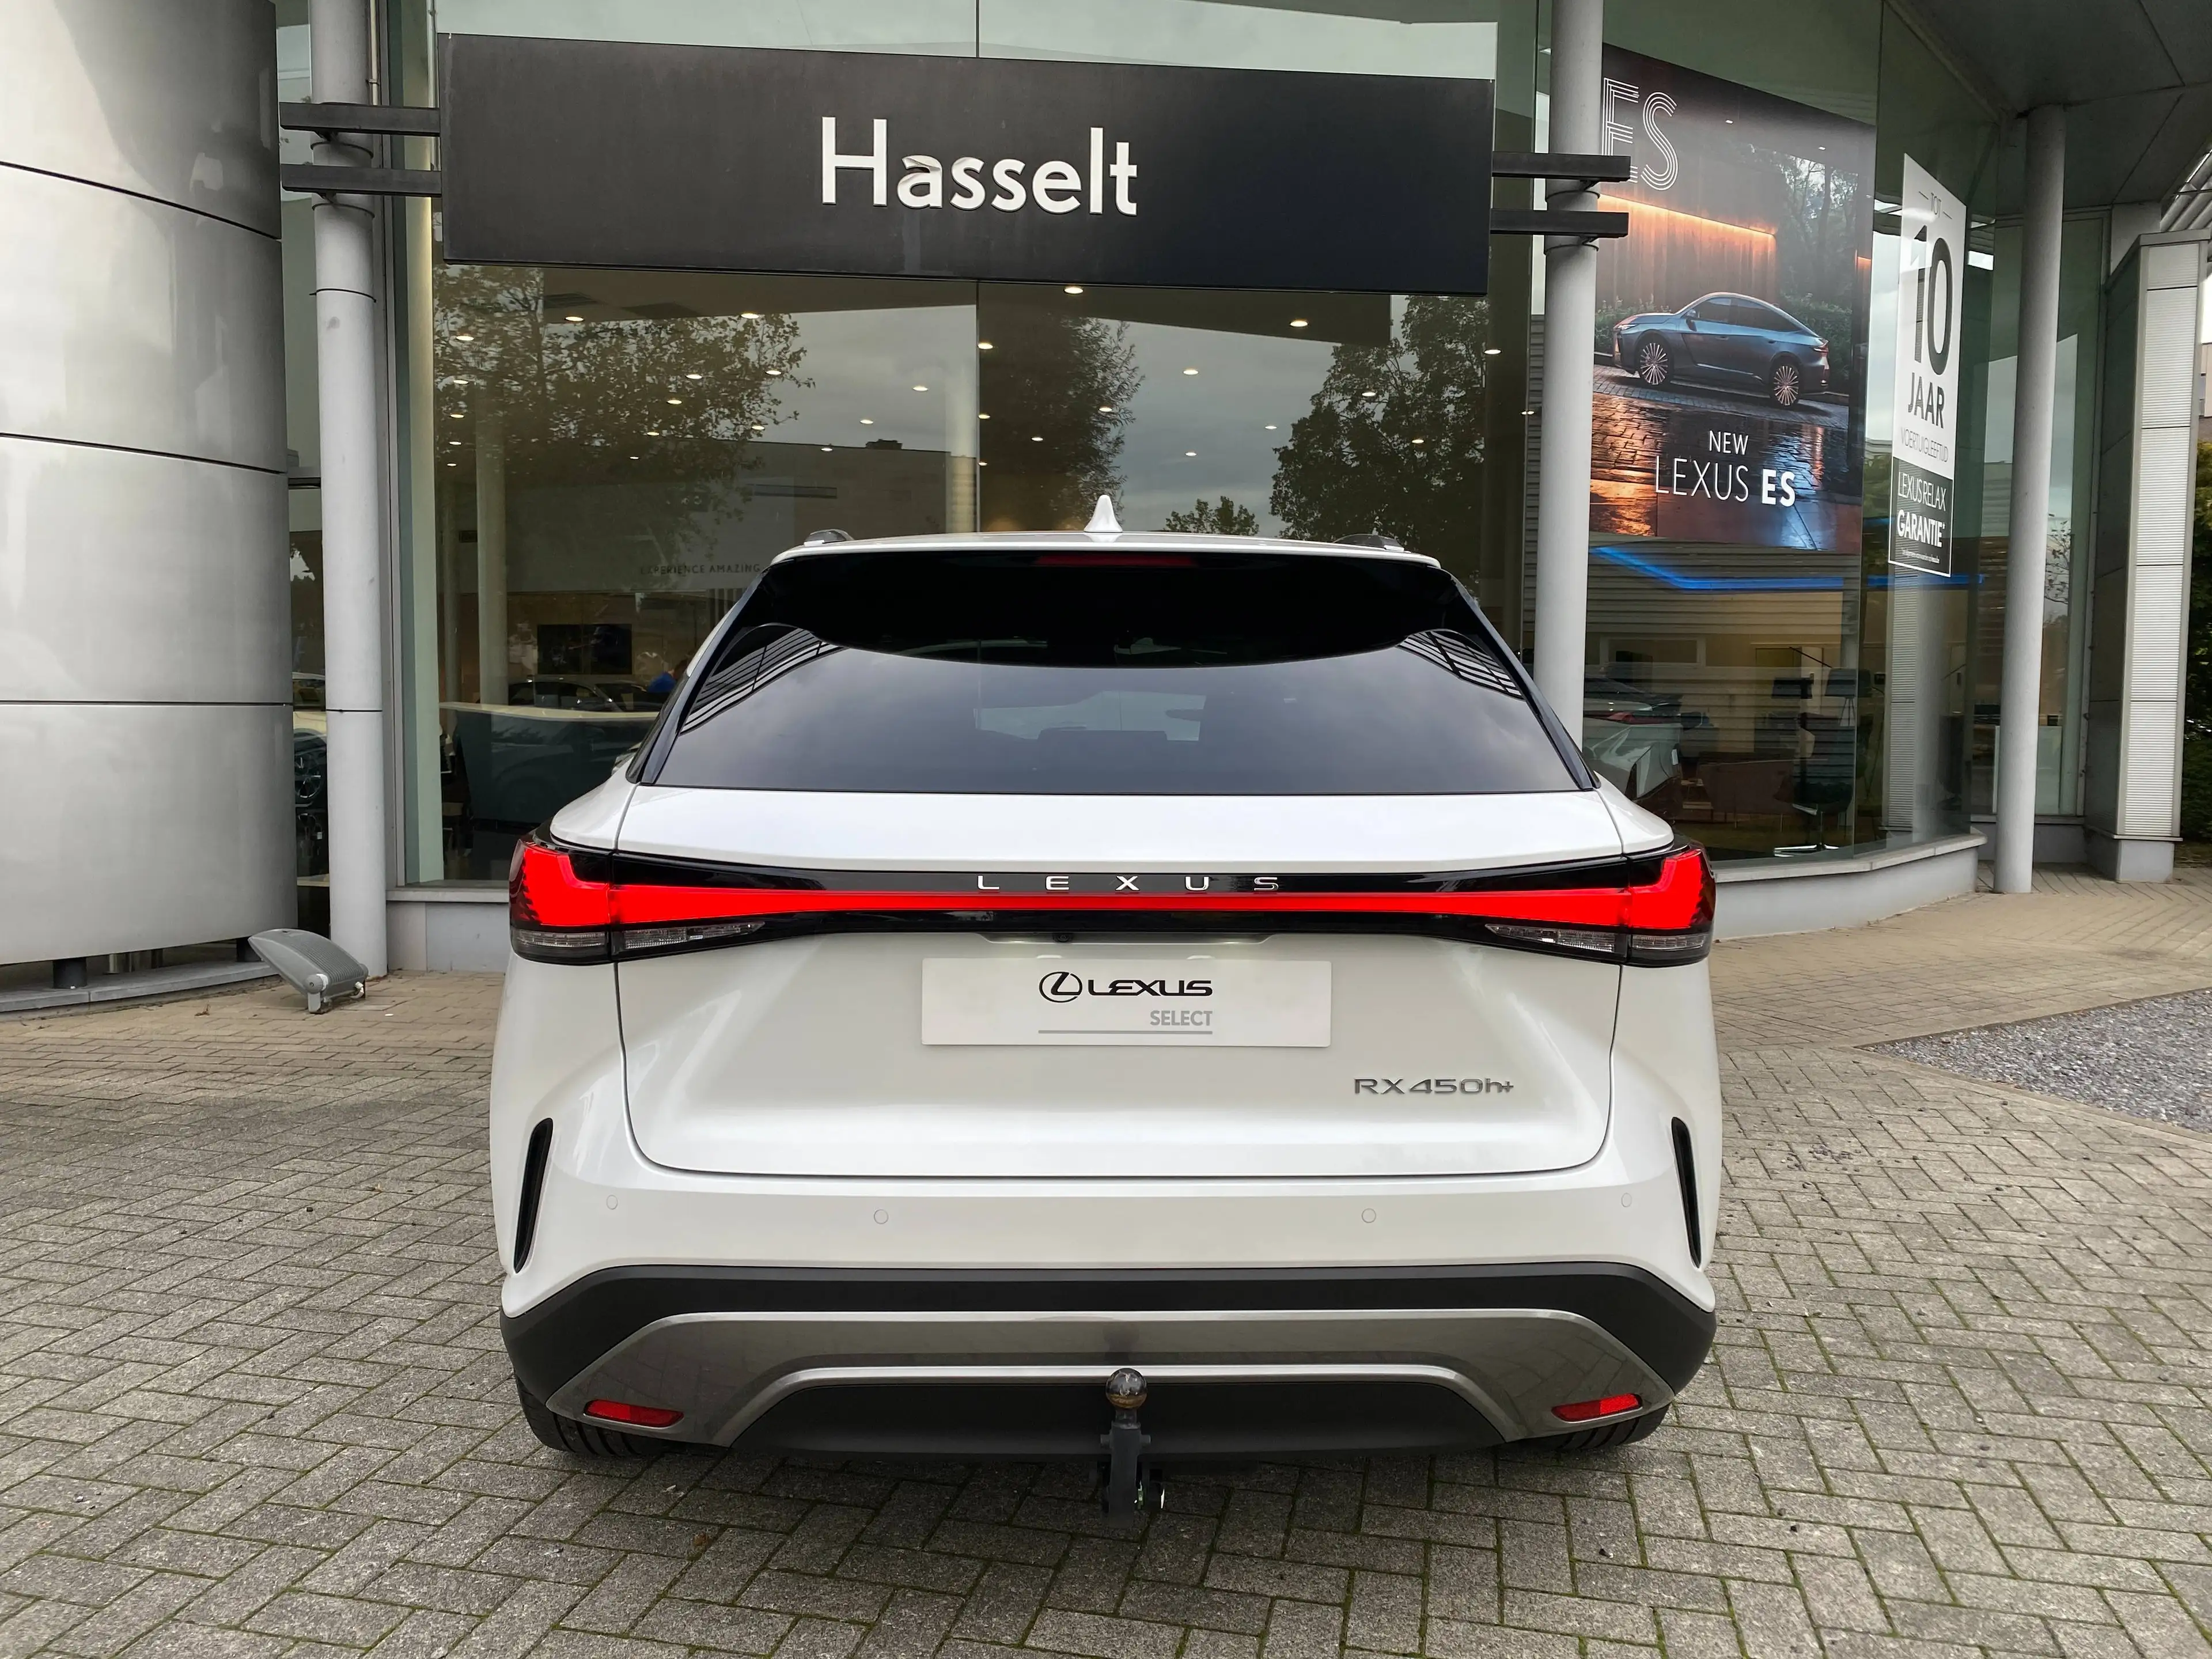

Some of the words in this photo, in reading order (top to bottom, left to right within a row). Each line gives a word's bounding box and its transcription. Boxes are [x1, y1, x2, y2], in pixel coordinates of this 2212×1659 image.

[1601, 77, 1679, 191] ES
[821, 116, 1138, 217] Hasselt
[1930, 191, 1942, 218] TOT
[1910, 225, 1953, 376] 10
[1908, 372, 1944, 429] JAAR
[1709, 430, 1749, 455] NEW
[1655, 455, 1749, 502] LEXUS
[1762, 468, 1796, 507] ES
[709, 564, 761, 574] AMAZING
[978, 875, 1279, 892] LEXUS
[1088, 979, 1213, 997] LEXUS
[1149, 1010, 1213, 1027] SELECT
